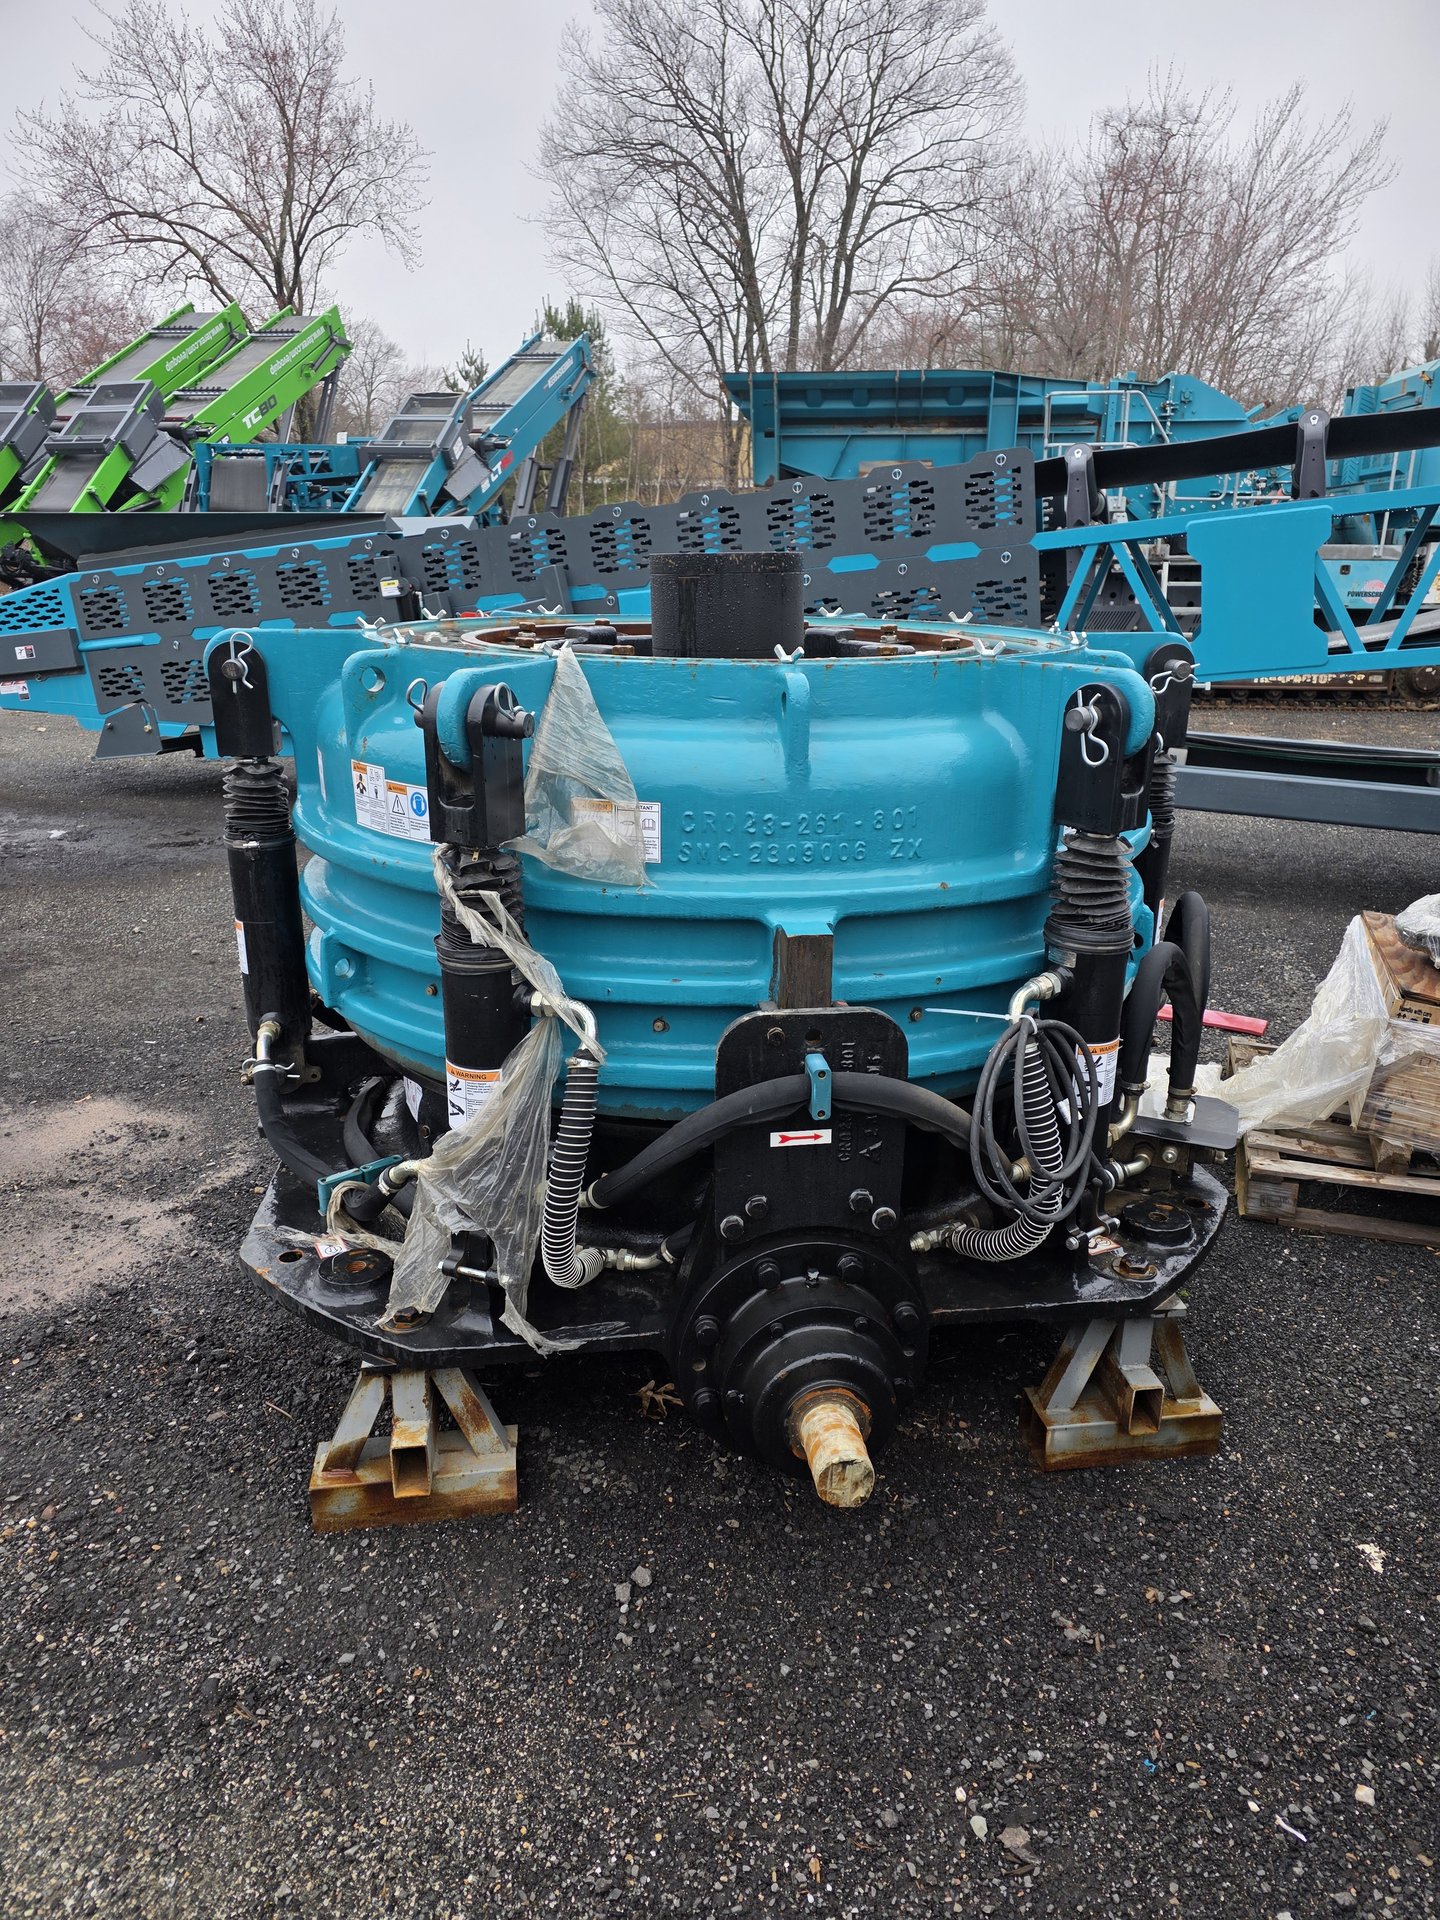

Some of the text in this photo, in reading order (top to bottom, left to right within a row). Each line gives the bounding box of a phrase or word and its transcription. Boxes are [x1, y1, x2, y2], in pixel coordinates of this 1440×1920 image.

[242, 394, 278, 429] TC80
[889, 837, 923, 859] ZX
[455, 1071, 487, 1080] WARNING
